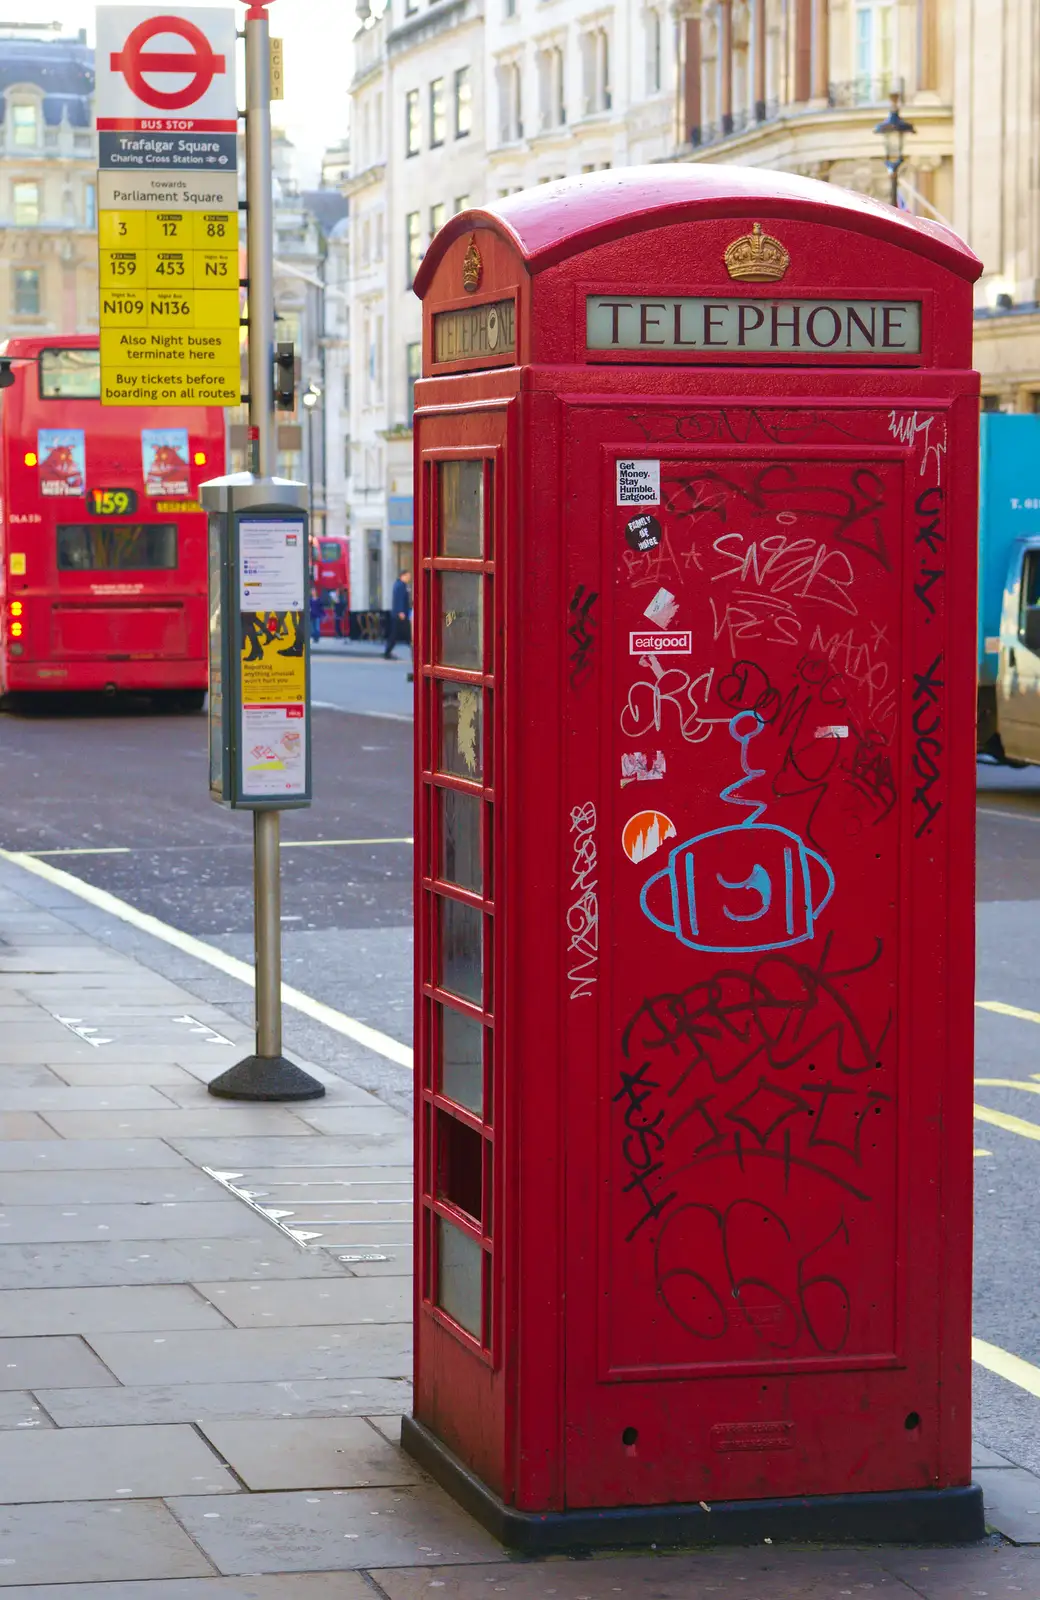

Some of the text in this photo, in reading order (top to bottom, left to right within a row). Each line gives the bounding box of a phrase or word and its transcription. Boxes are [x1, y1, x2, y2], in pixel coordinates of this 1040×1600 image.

[141, 120, 194, 130] BUS STOP
[120, 138, 220, 153] Trafalgar Square
[111, 154, 204, 164] Charing Cross Station
[151, 180, 187, 188] towards
[113, 191, 223, 204] Parliament Square
[119, 222, 127, 236] 3
[162, 223, 178, 237] 12
[207, 223, 226, 237] 88
[110, 262, 136, 275] 159
[156, 262, 185, 275] 453
[205, 263, 228, 276] N3
[103, 301, 144, 314] N109
[151, 302, 190, 315] N136
[439, 307, 515, 356] TELEPHONE
[597, 303, 907, 348] TELEPHONE
[120, 336, 222, 347] Also Night buses
[127, 349, 215, 359] terminate here
[116, 374, 225, 386] Buy tickets before
[105, 388, 236, 400] boarding on all routes
[620, 470, 650, 479] Money.
[620, 478, 639, 487] Stay
[93, 489, 129, 514] 159
[620, 493, 658, 502] Eatgood.
[639, 527, 650, 539] OF
[635, 635, 687, 650] eatgood
